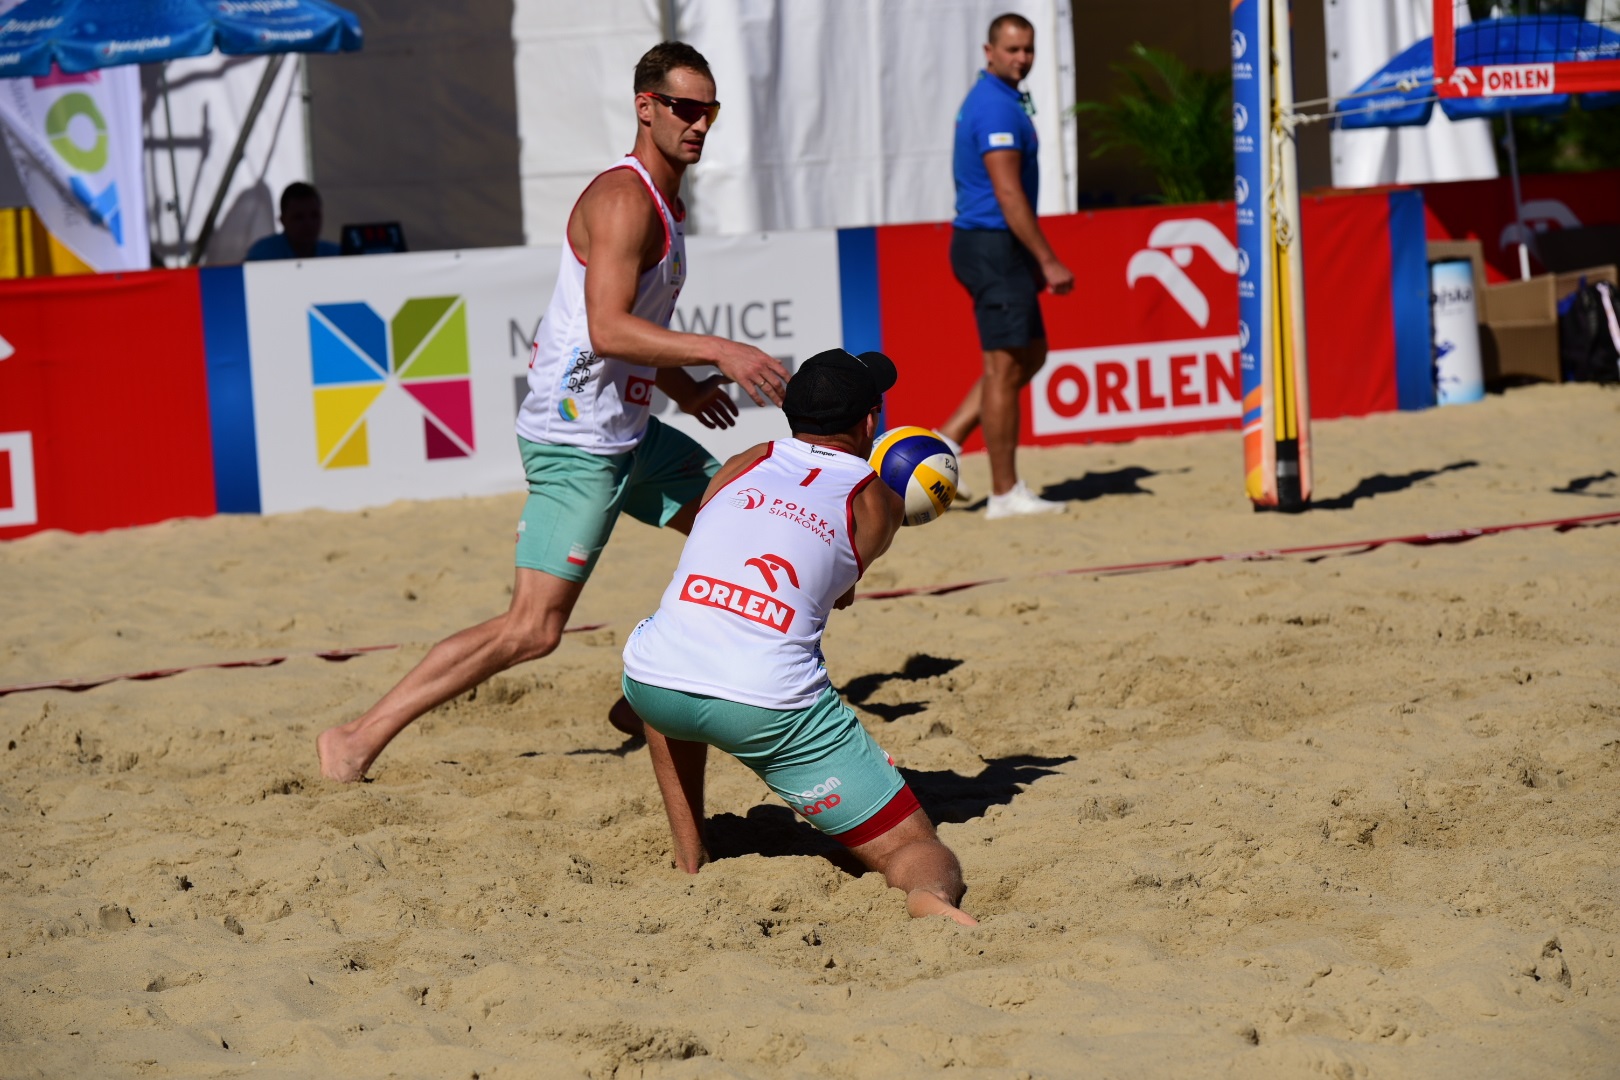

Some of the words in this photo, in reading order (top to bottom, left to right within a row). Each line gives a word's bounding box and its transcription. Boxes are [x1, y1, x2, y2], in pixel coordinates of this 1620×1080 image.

[1488, 69, 1549, 91] ORLEN
[568, 351, 589, 392] VOLLEY
[1046, 350, 1241, 419] ORLEN
[799, 468, 822, 487] 1
[768, 507, 831, 547] SIATKÓWKA
[773, 498, 835, 539] POLSKA
[688, 578, 789, 627] ORLEN
